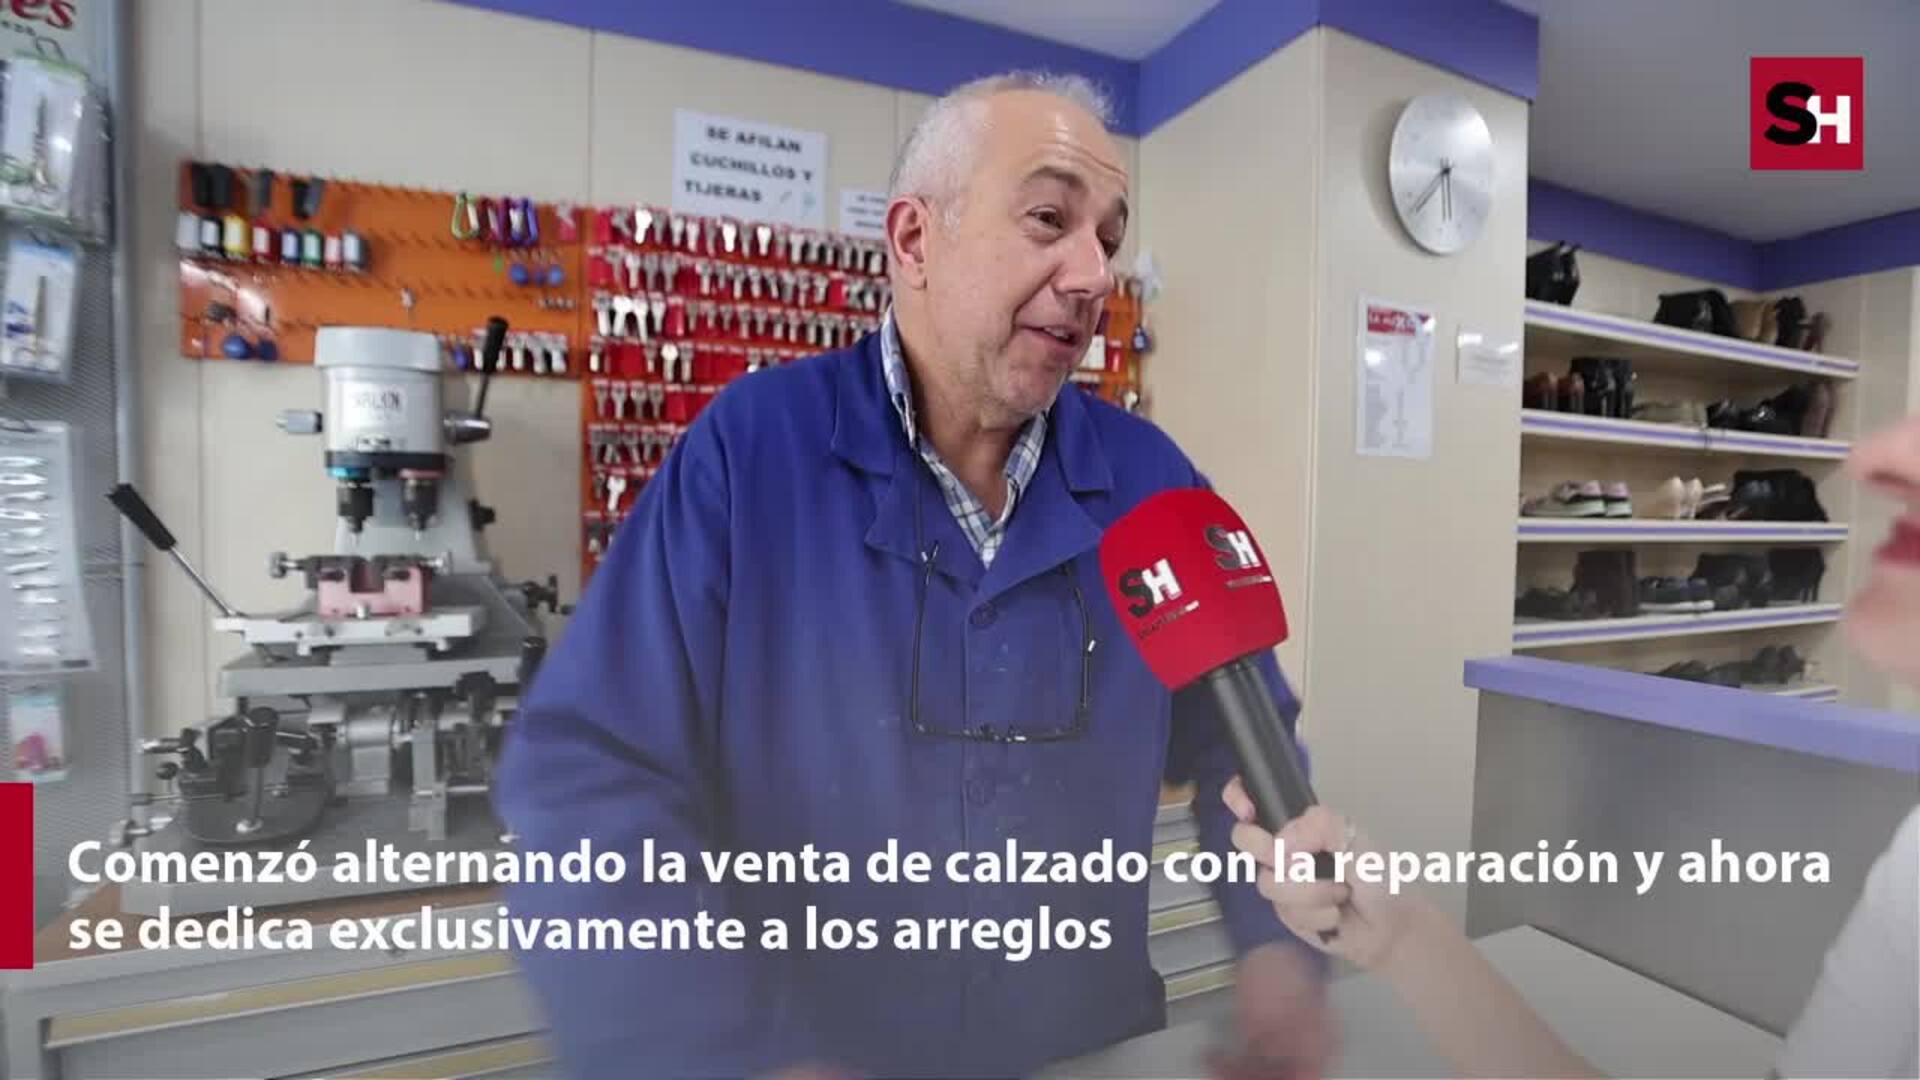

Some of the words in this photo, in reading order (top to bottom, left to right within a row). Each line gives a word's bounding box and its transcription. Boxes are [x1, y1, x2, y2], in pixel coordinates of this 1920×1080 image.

[707, 125, 729, 141] SE
[735, 131, 802, 153] AFILAN
[690, 152, 796, 180] CUCHILLOS
[802, 169, 813, 182] Y
[684, 179, 762, 202] TIJERAS
[1203, 523, 1263, 571] SH
[1118, 558, 1183, 619] SH
